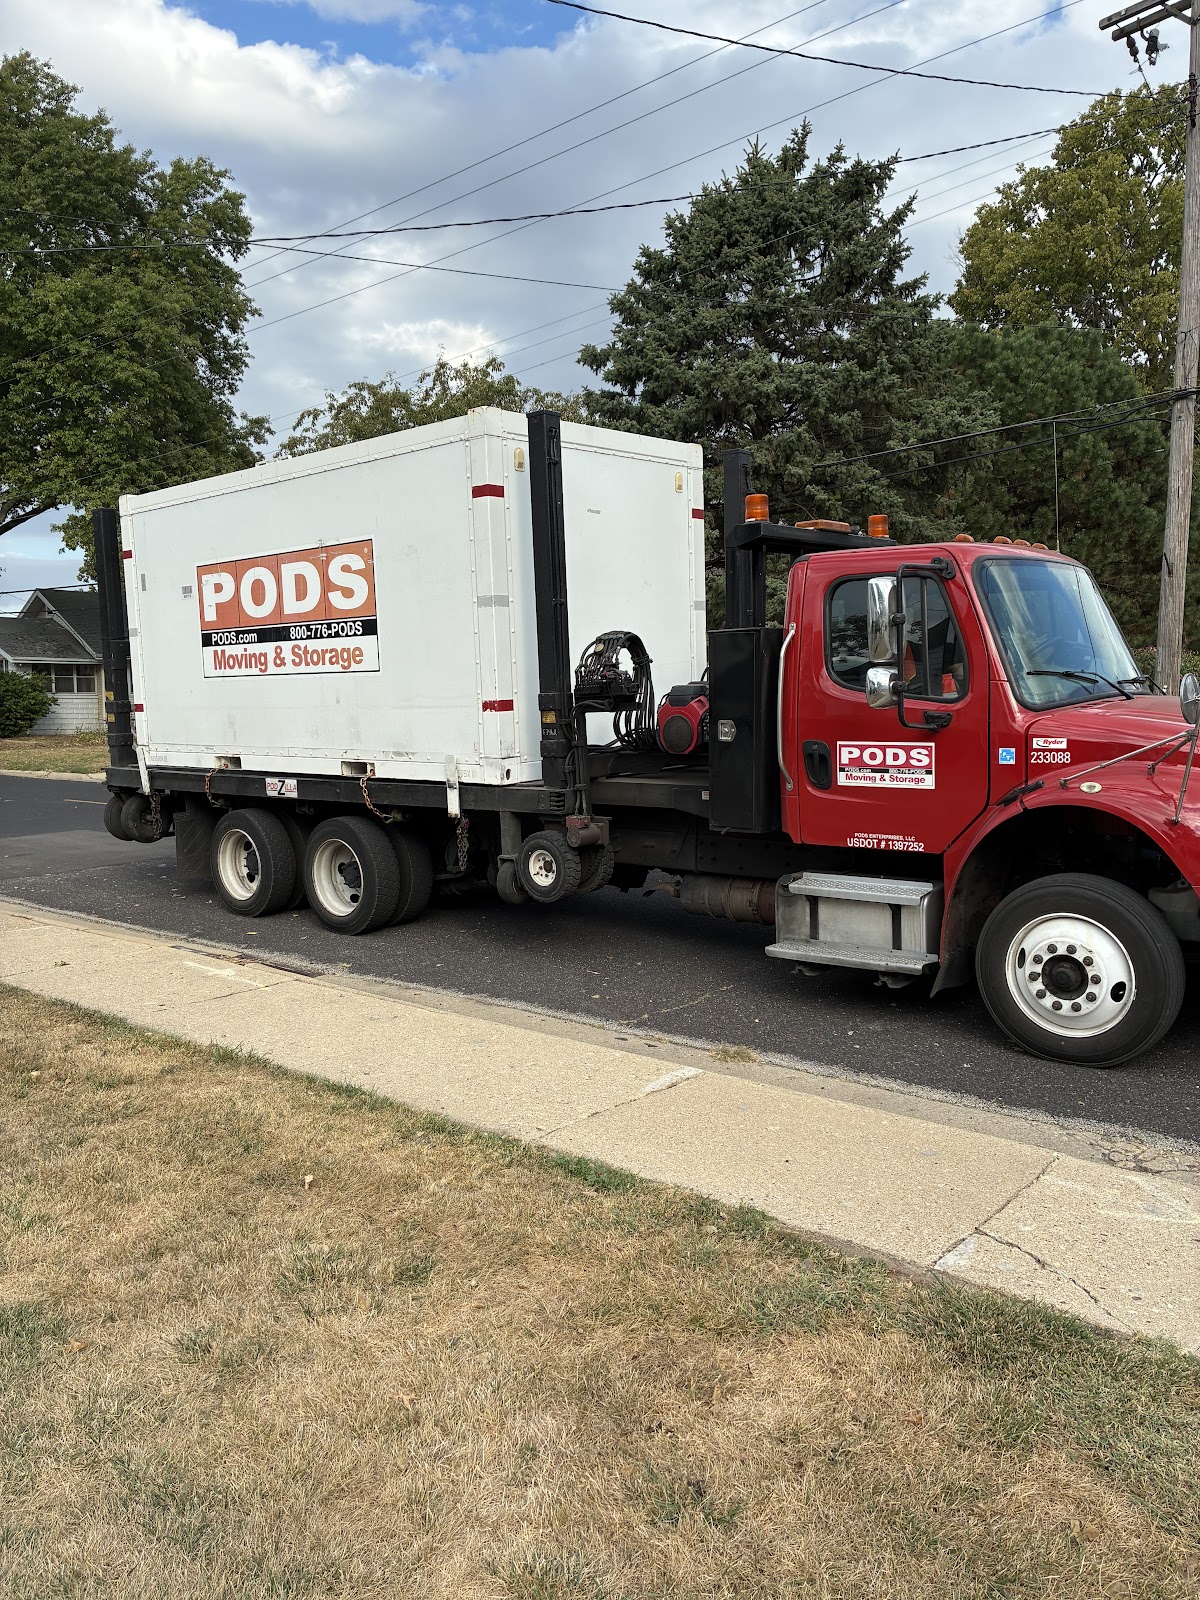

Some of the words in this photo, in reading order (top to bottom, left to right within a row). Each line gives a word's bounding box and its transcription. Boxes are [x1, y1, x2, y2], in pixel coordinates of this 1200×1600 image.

[201, 553, 369, 622] PODS
[211, 632, 258, 645] PODS.com
[289, 621, 363, 639] 800-776-PODS
[213, 647, 268, 673] Moving
[273, 645, 287, 668] &
[291, 643, 364, 670] Storage
[840, 747, 930, 767] PODS
[1030, 751, 1070, 764] 233088
[845, 773, 877, 783] Moving
[879, 774, 886, 782] &
[889, 775, 926, 784] Storage
[847, 838, 878, 849] USDOT
[880, 840, 886, 849] #
[888, 841, 925, 852] 1397252
[869, 833, 904, 841] ENTERPRISES,
